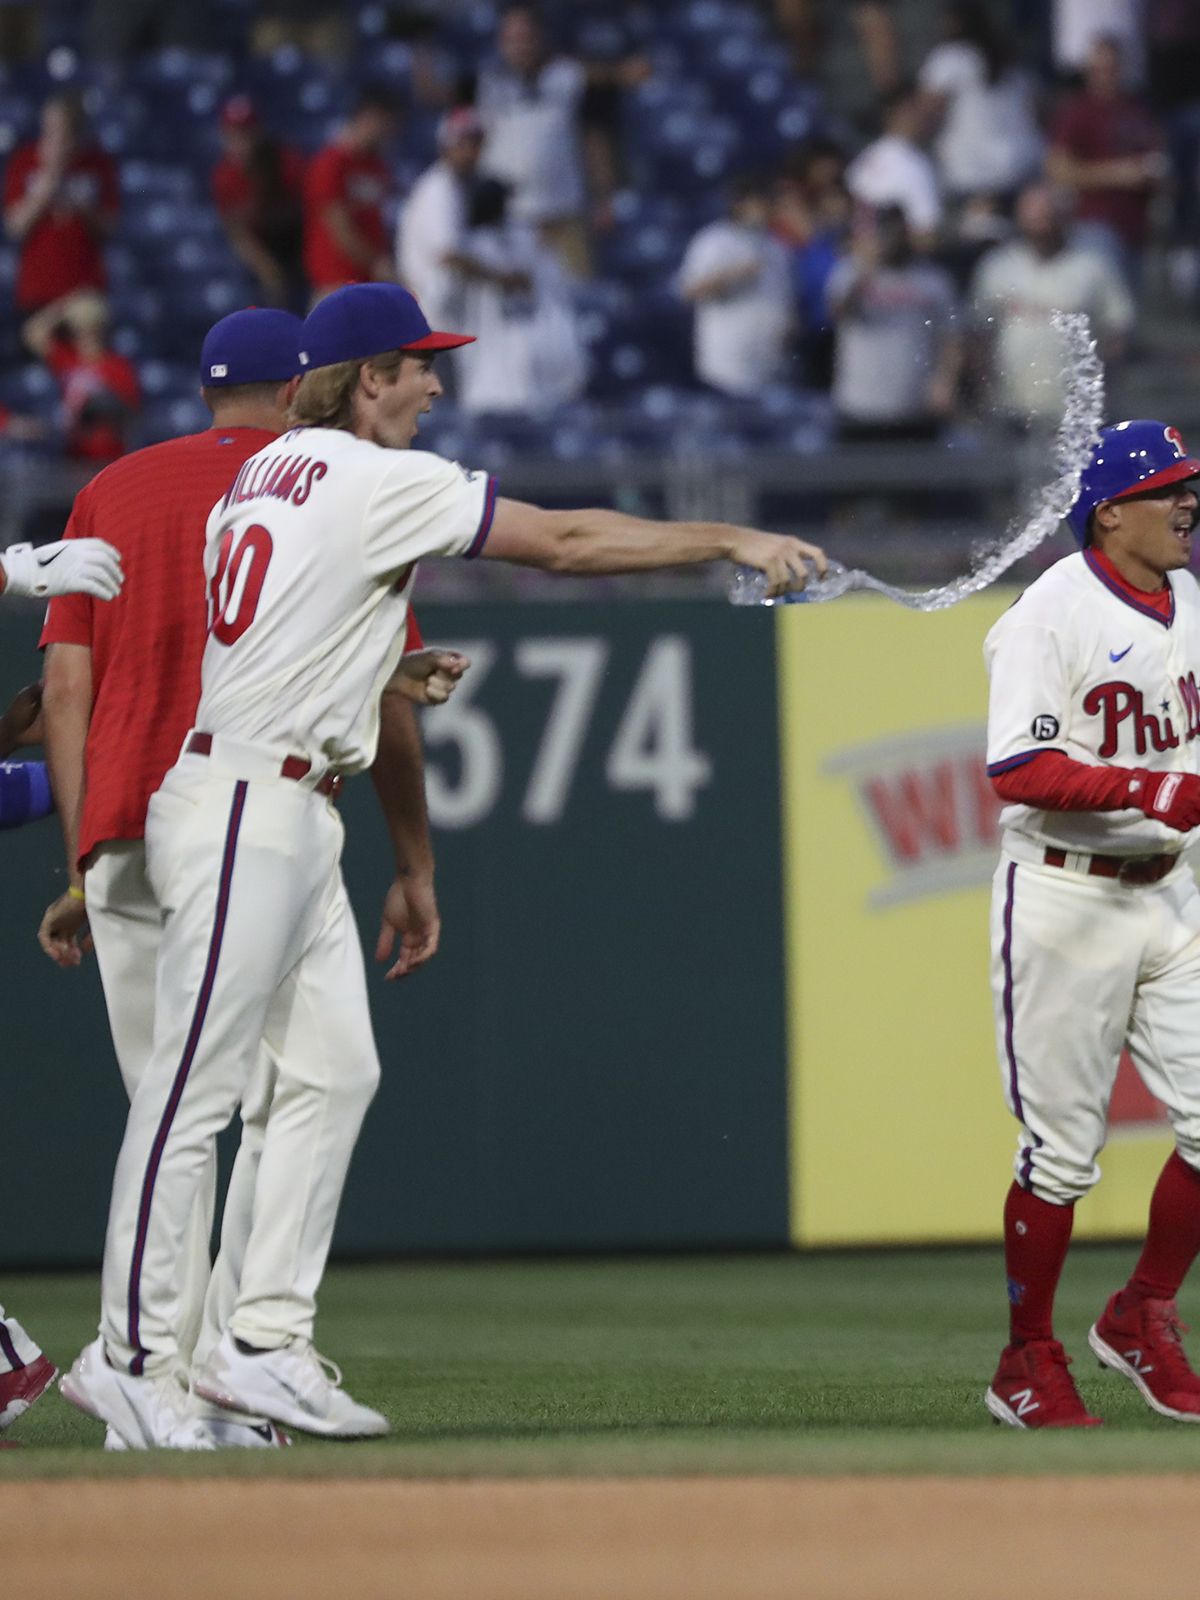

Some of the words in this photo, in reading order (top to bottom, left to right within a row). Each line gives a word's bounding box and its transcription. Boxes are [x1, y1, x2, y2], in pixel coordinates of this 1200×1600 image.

[421, 637, 713, 829] 374
[1033, 716, 1058, 737] 15
[1008, 1388, 1041, 1418] N
